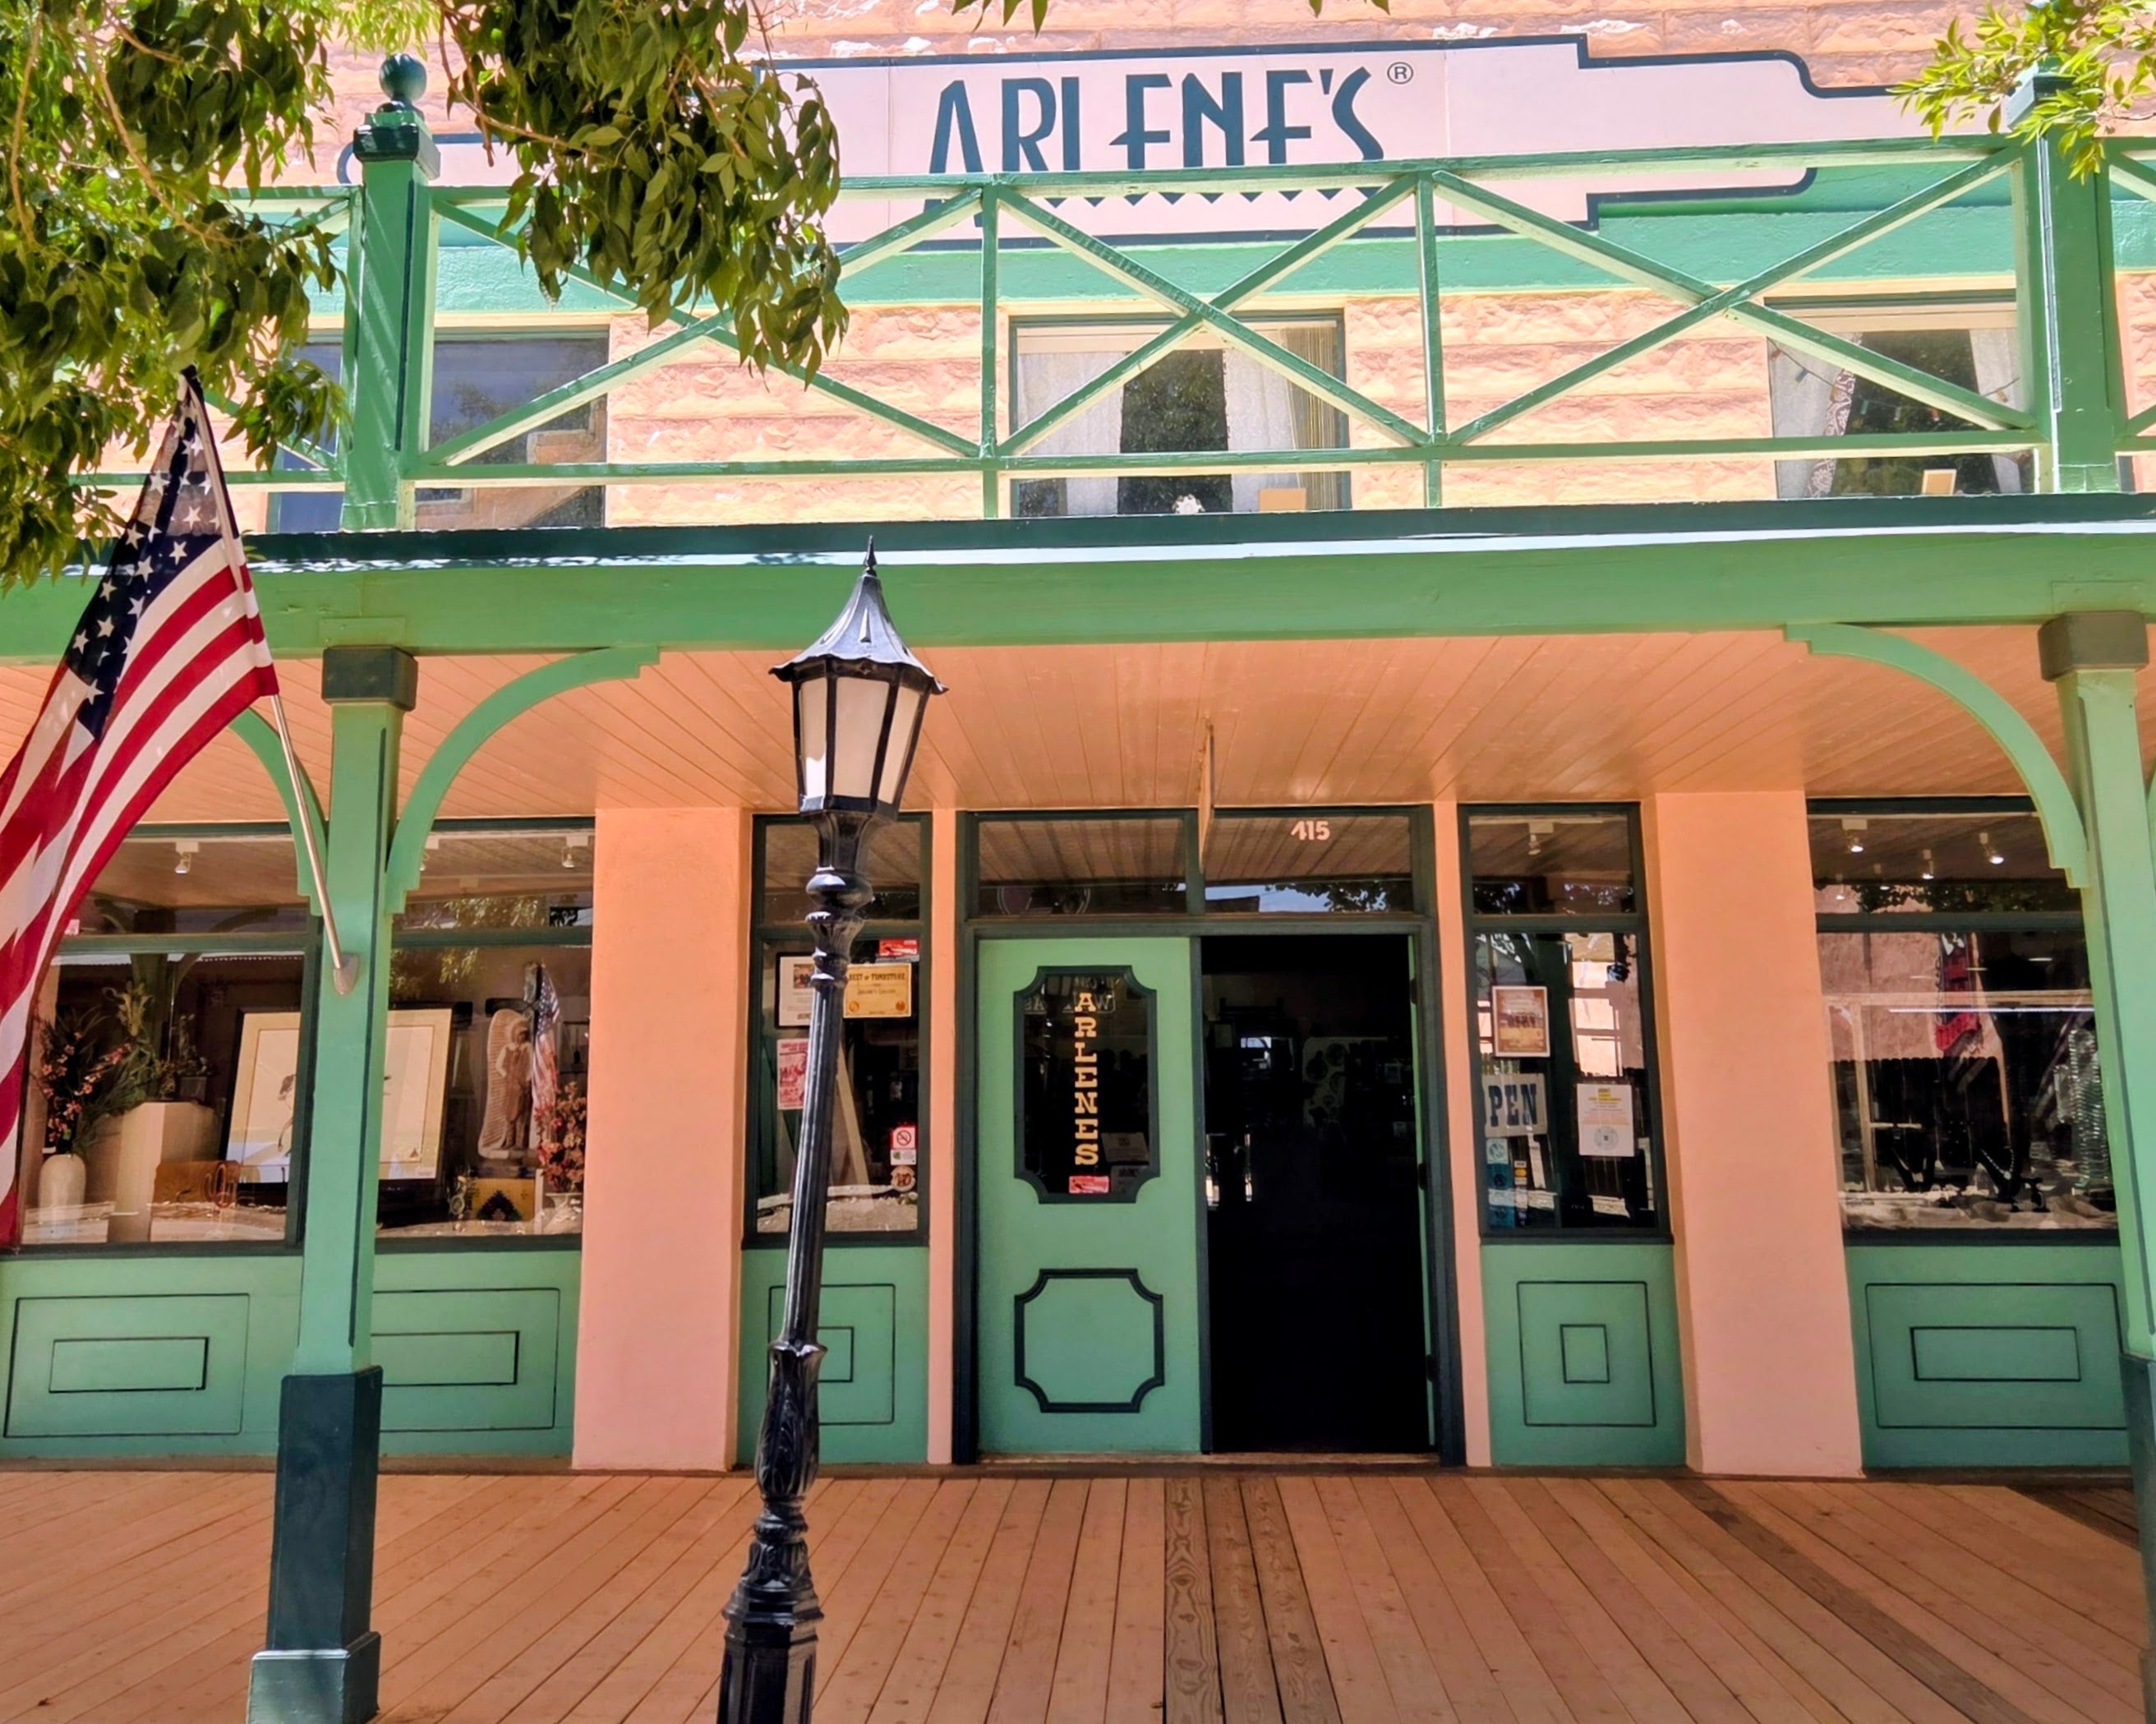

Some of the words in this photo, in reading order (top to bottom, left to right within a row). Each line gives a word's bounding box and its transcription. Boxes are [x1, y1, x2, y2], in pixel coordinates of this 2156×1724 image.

[1291, 820, 1331, 841] 415
[1074, 993, 1099, 1165] ARLENES
[1485, 1083, 1538, 1127] PEN
